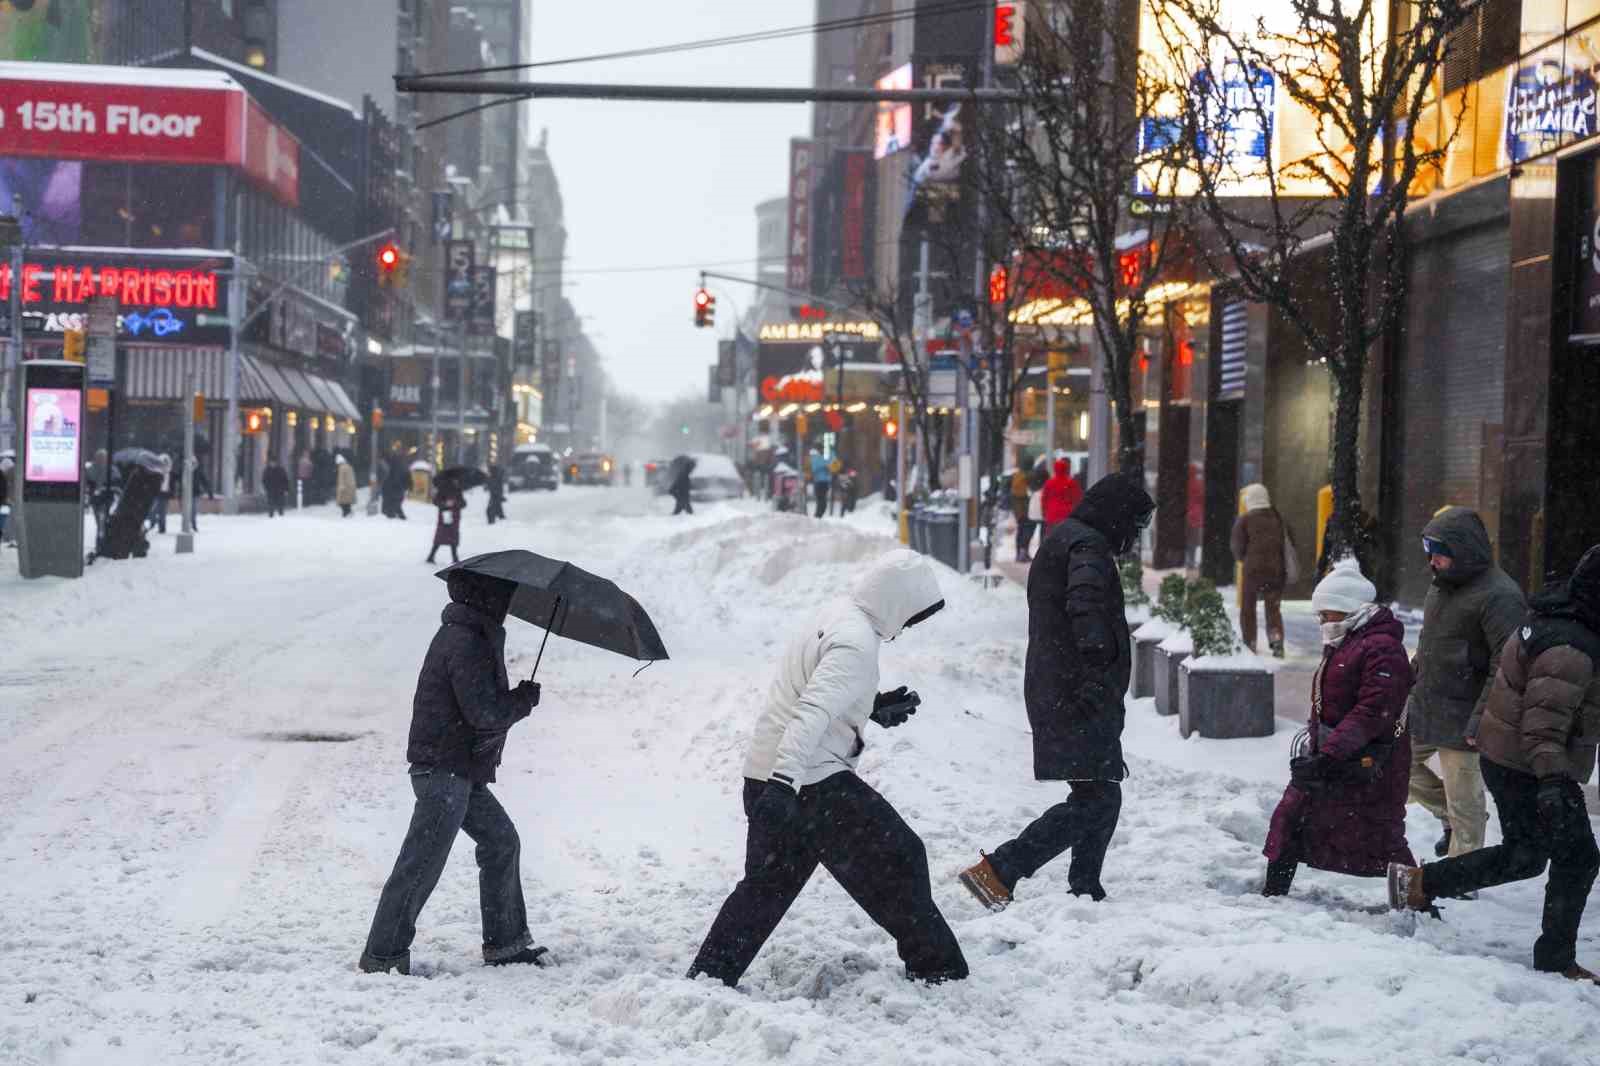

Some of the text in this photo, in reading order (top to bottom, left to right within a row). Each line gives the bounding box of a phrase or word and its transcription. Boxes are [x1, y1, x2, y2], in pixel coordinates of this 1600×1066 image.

[17, 100, 96, 133] 15th
[106, 104, 201, 137] Floor
[53, 264, 218, 308] HARRISON
